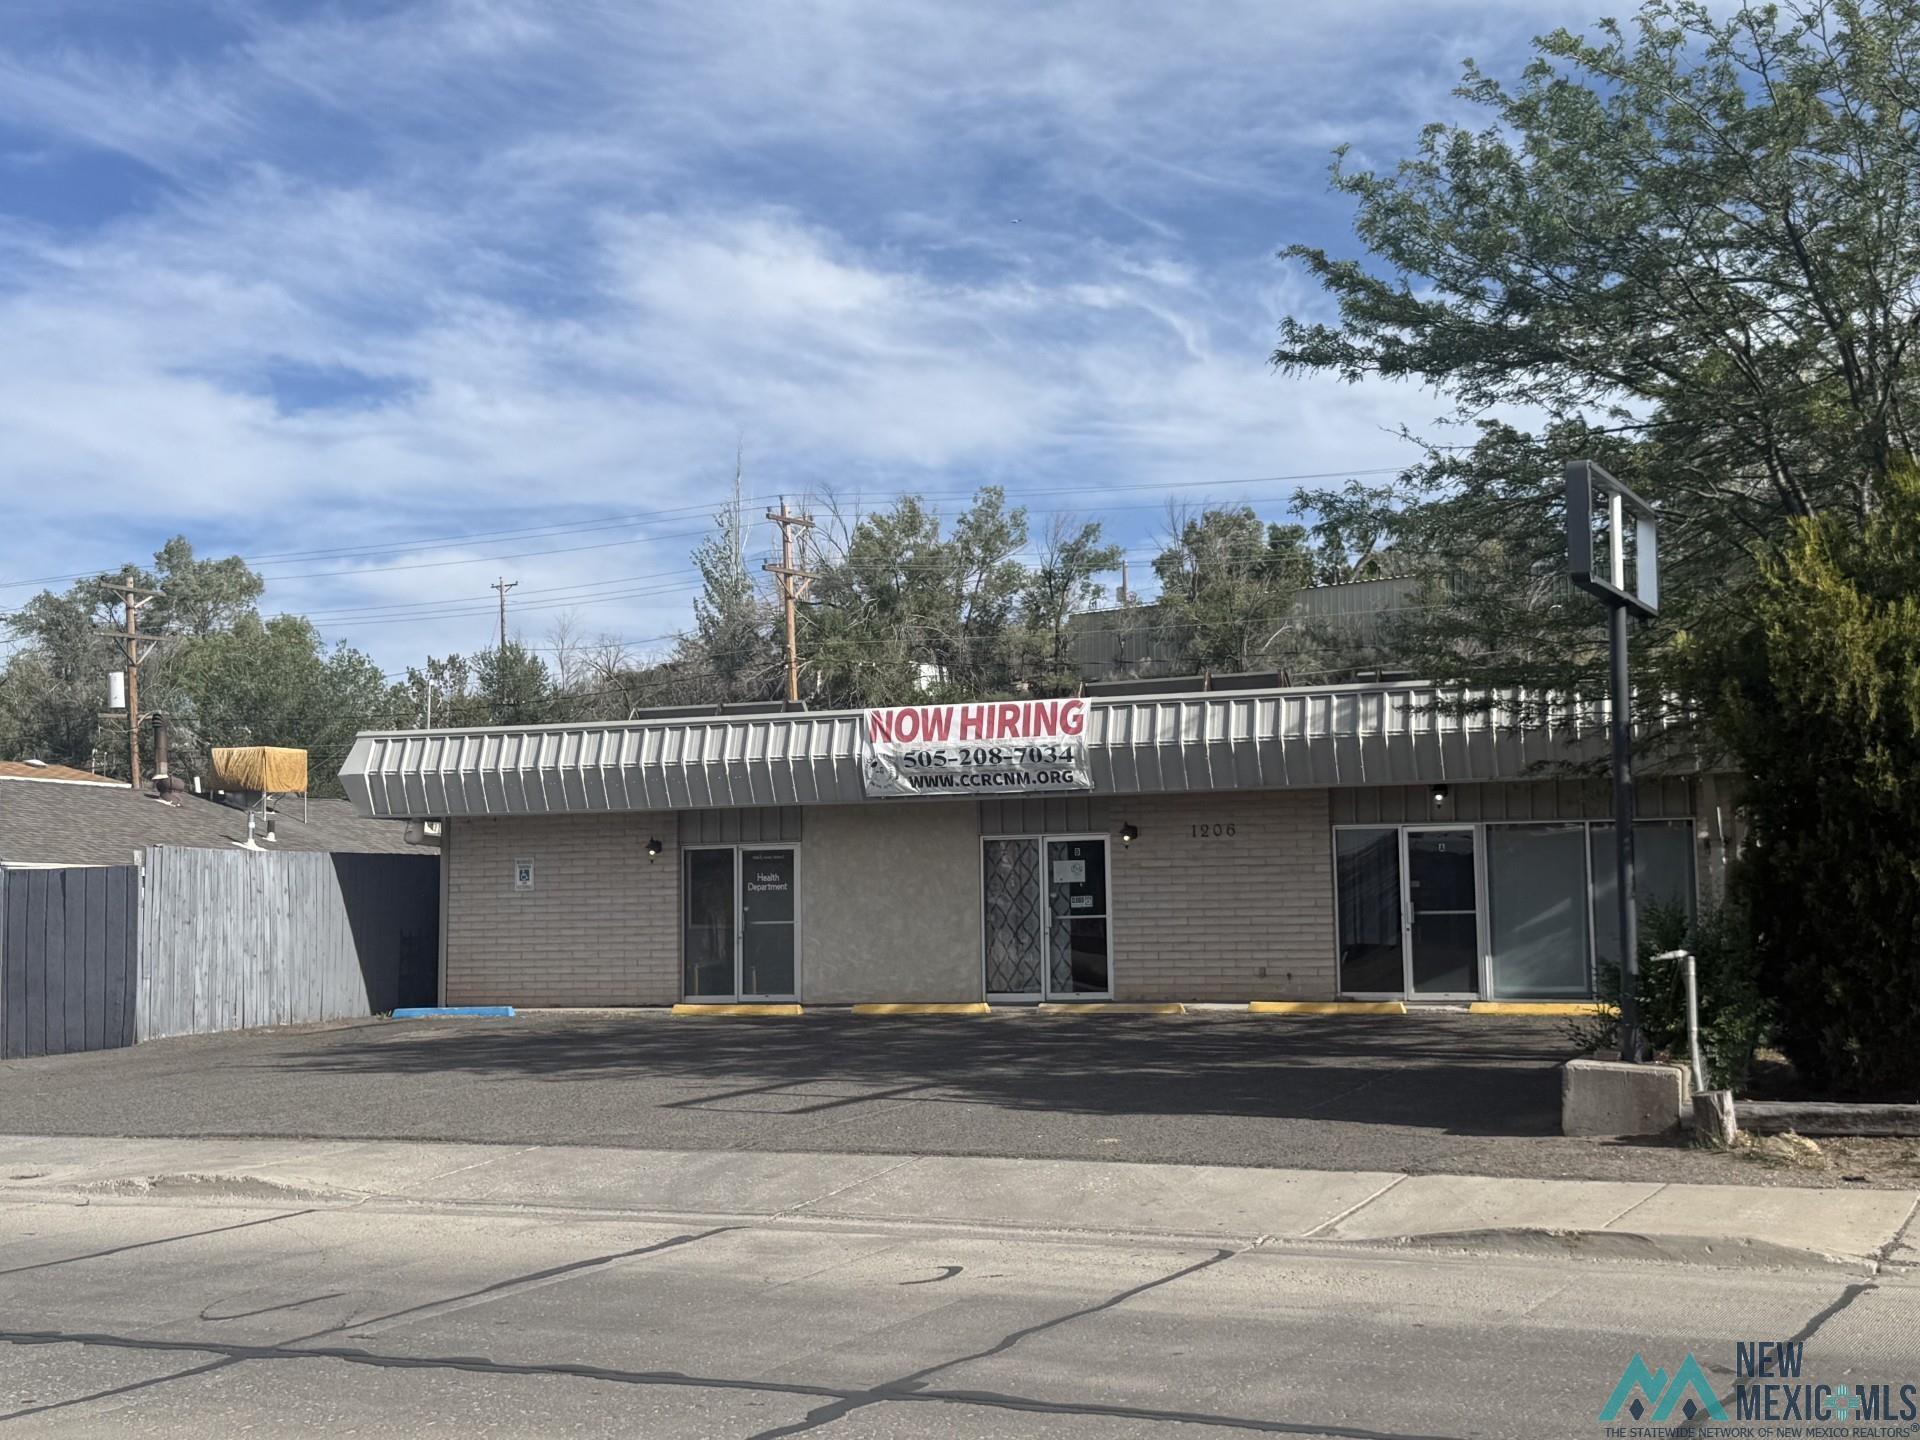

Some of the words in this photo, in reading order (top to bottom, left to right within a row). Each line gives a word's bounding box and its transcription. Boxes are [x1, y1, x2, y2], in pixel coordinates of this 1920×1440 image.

[870, 707, 954, 743] NOW
[959, 699, 1084, 741] HIRING
[903, 746, 1075, 768] 505-208-7034
[909, 770, 1074, 788] WWW.CCRCNM.ORG
[1192, 823, 1236, 837] 1206
[756, 872, 780, 882] Health
[747, 882, 788, 892] Department
